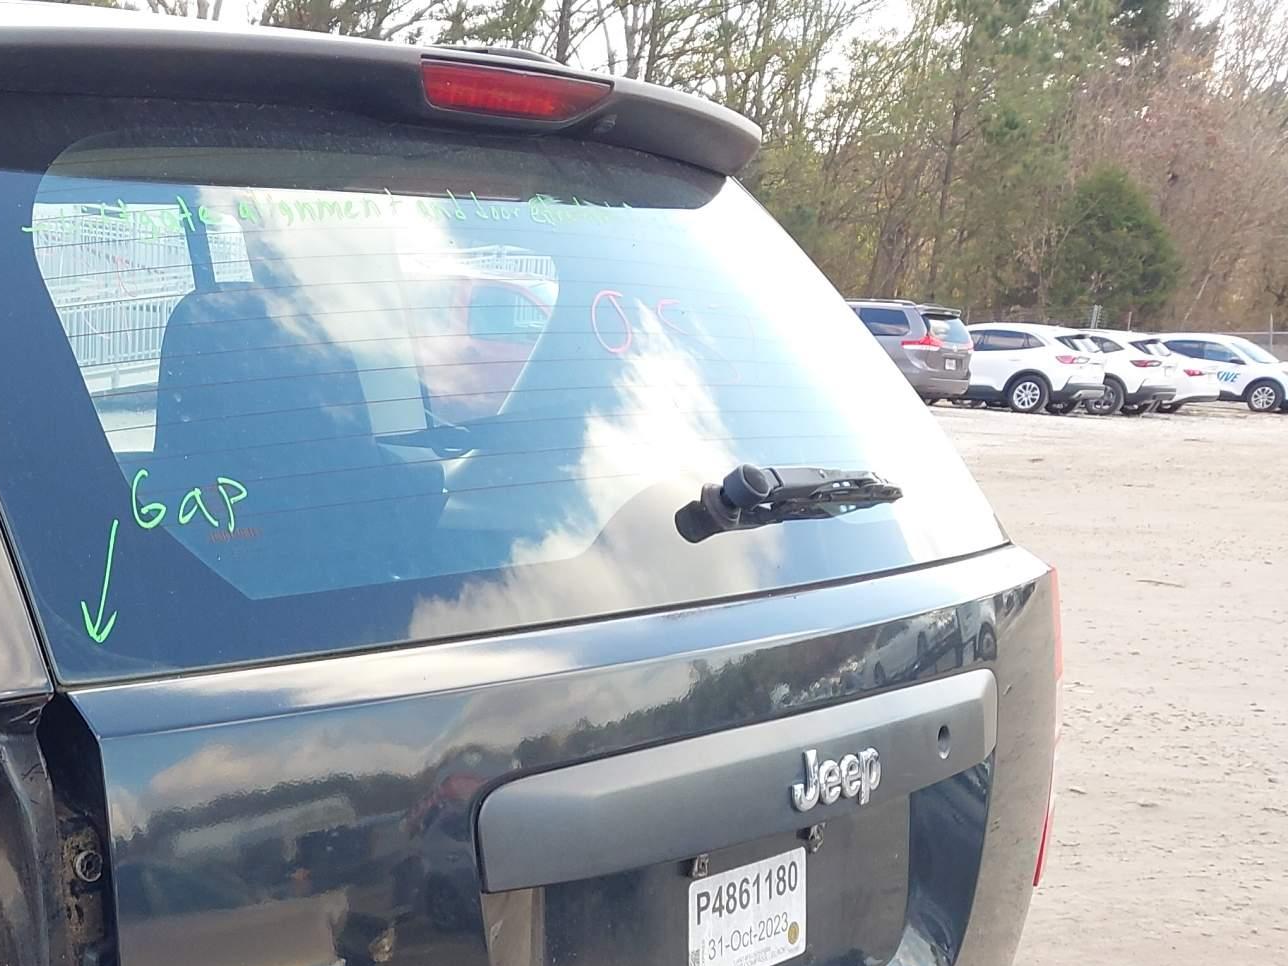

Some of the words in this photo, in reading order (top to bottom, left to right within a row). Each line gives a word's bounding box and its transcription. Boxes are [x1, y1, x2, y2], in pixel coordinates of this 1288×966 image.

[791, 747, 882, 812] Jeep
[696, 860, 799, 926] P4861180
[708, 911, 789, 961] 31-Oct-2023
